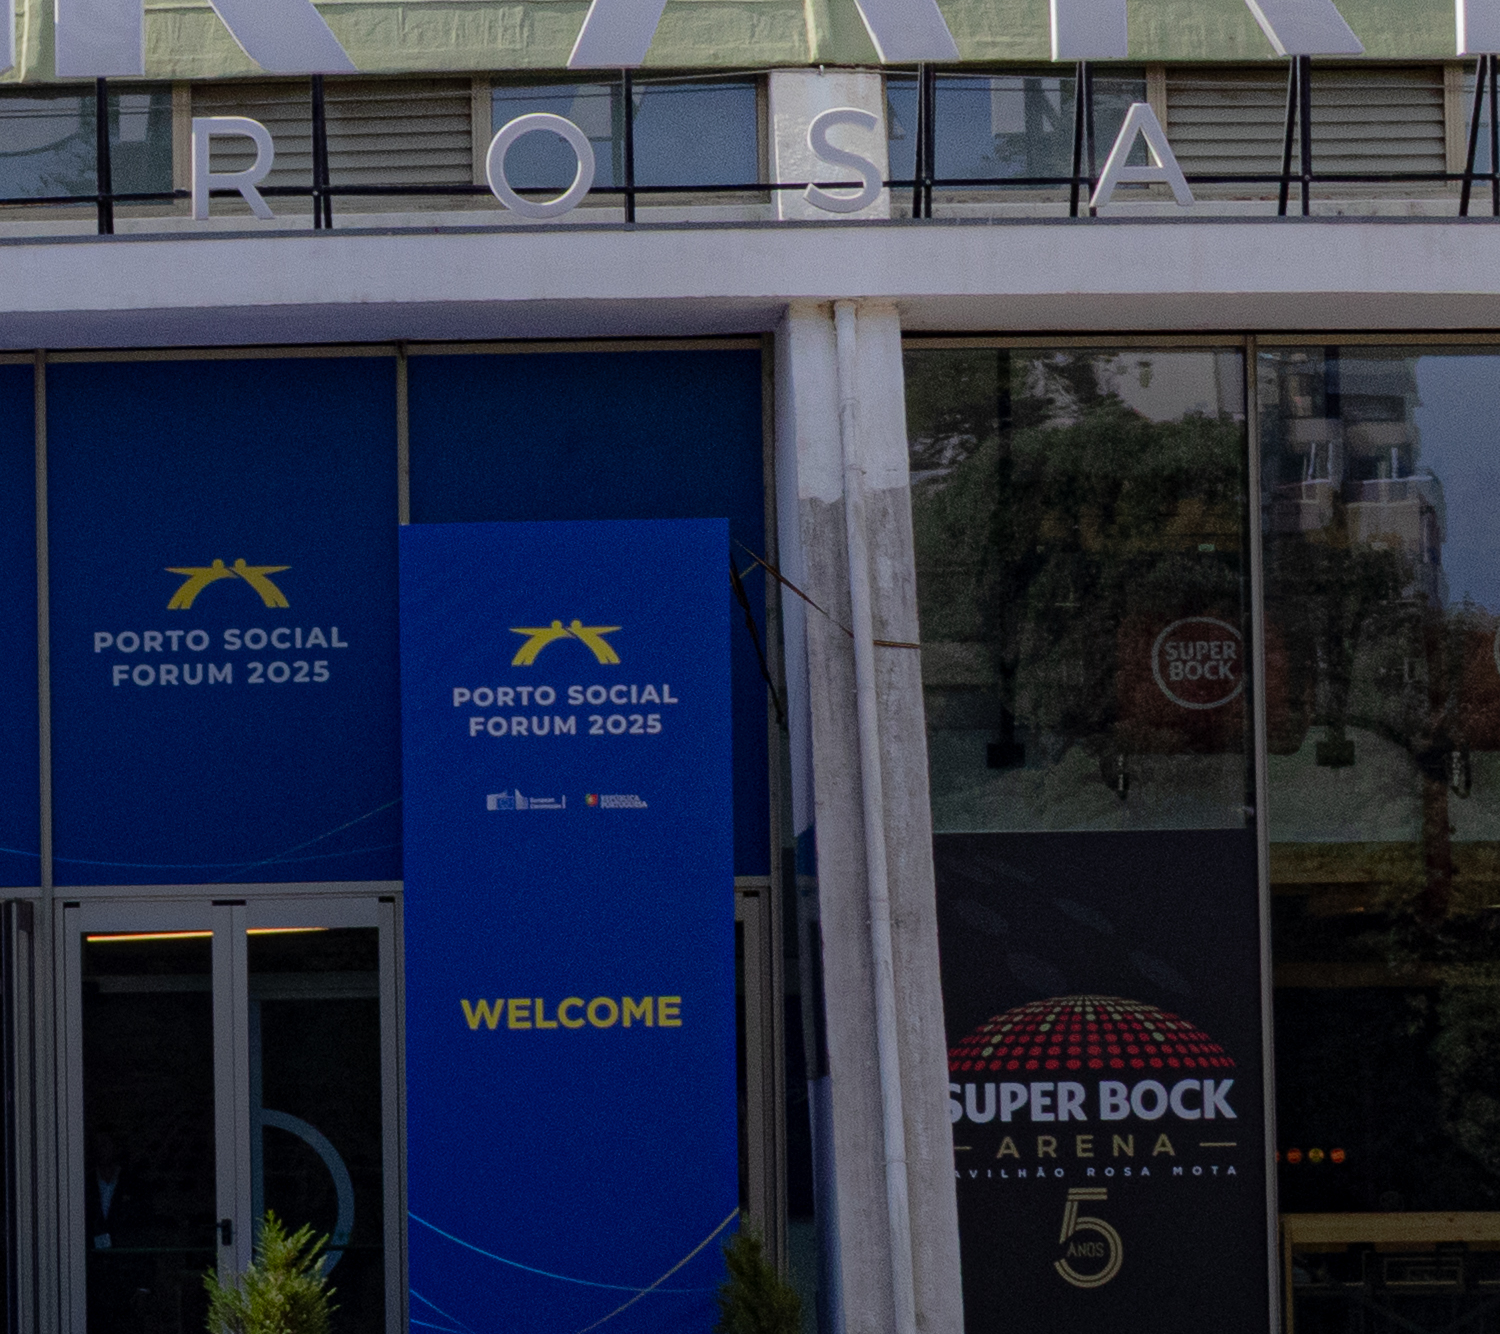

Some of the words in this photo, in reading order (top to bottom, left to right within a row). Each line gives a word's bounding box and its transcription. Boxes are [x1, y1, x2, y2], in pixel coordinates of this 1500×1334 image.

[192, 103, 1194, 221] ROSA
[94, 629, 210, 654] PORTO
[223, 626, 349, 651] SOCIAL
[1164, 640, 1237, 660] SUPER
[113, 663, 234, 687] FORUM
[247, 660, 331, 685] 2025
[1169, 660, 1235, 681] BOCK
[453, 685, 557, 707] PORTO
[567, 683, 679, 706] SOCIAL
[469, 715, 577, 737] FORUM
[588, 713, 663, 736] 2025
[460, 995, 684, 1031] WELCOME
[1099, 1079, 1238, 1121] BOCK
[996, 1133, 1176, 1159] ARENA
[1087, 1166, 1151, 1178] ROSA
[1173, 1165, 1238, 1176] MOTA
[1054, 1187, 1124, 1289] 5
[1067, 1241, 1105, 1259] ANOS
